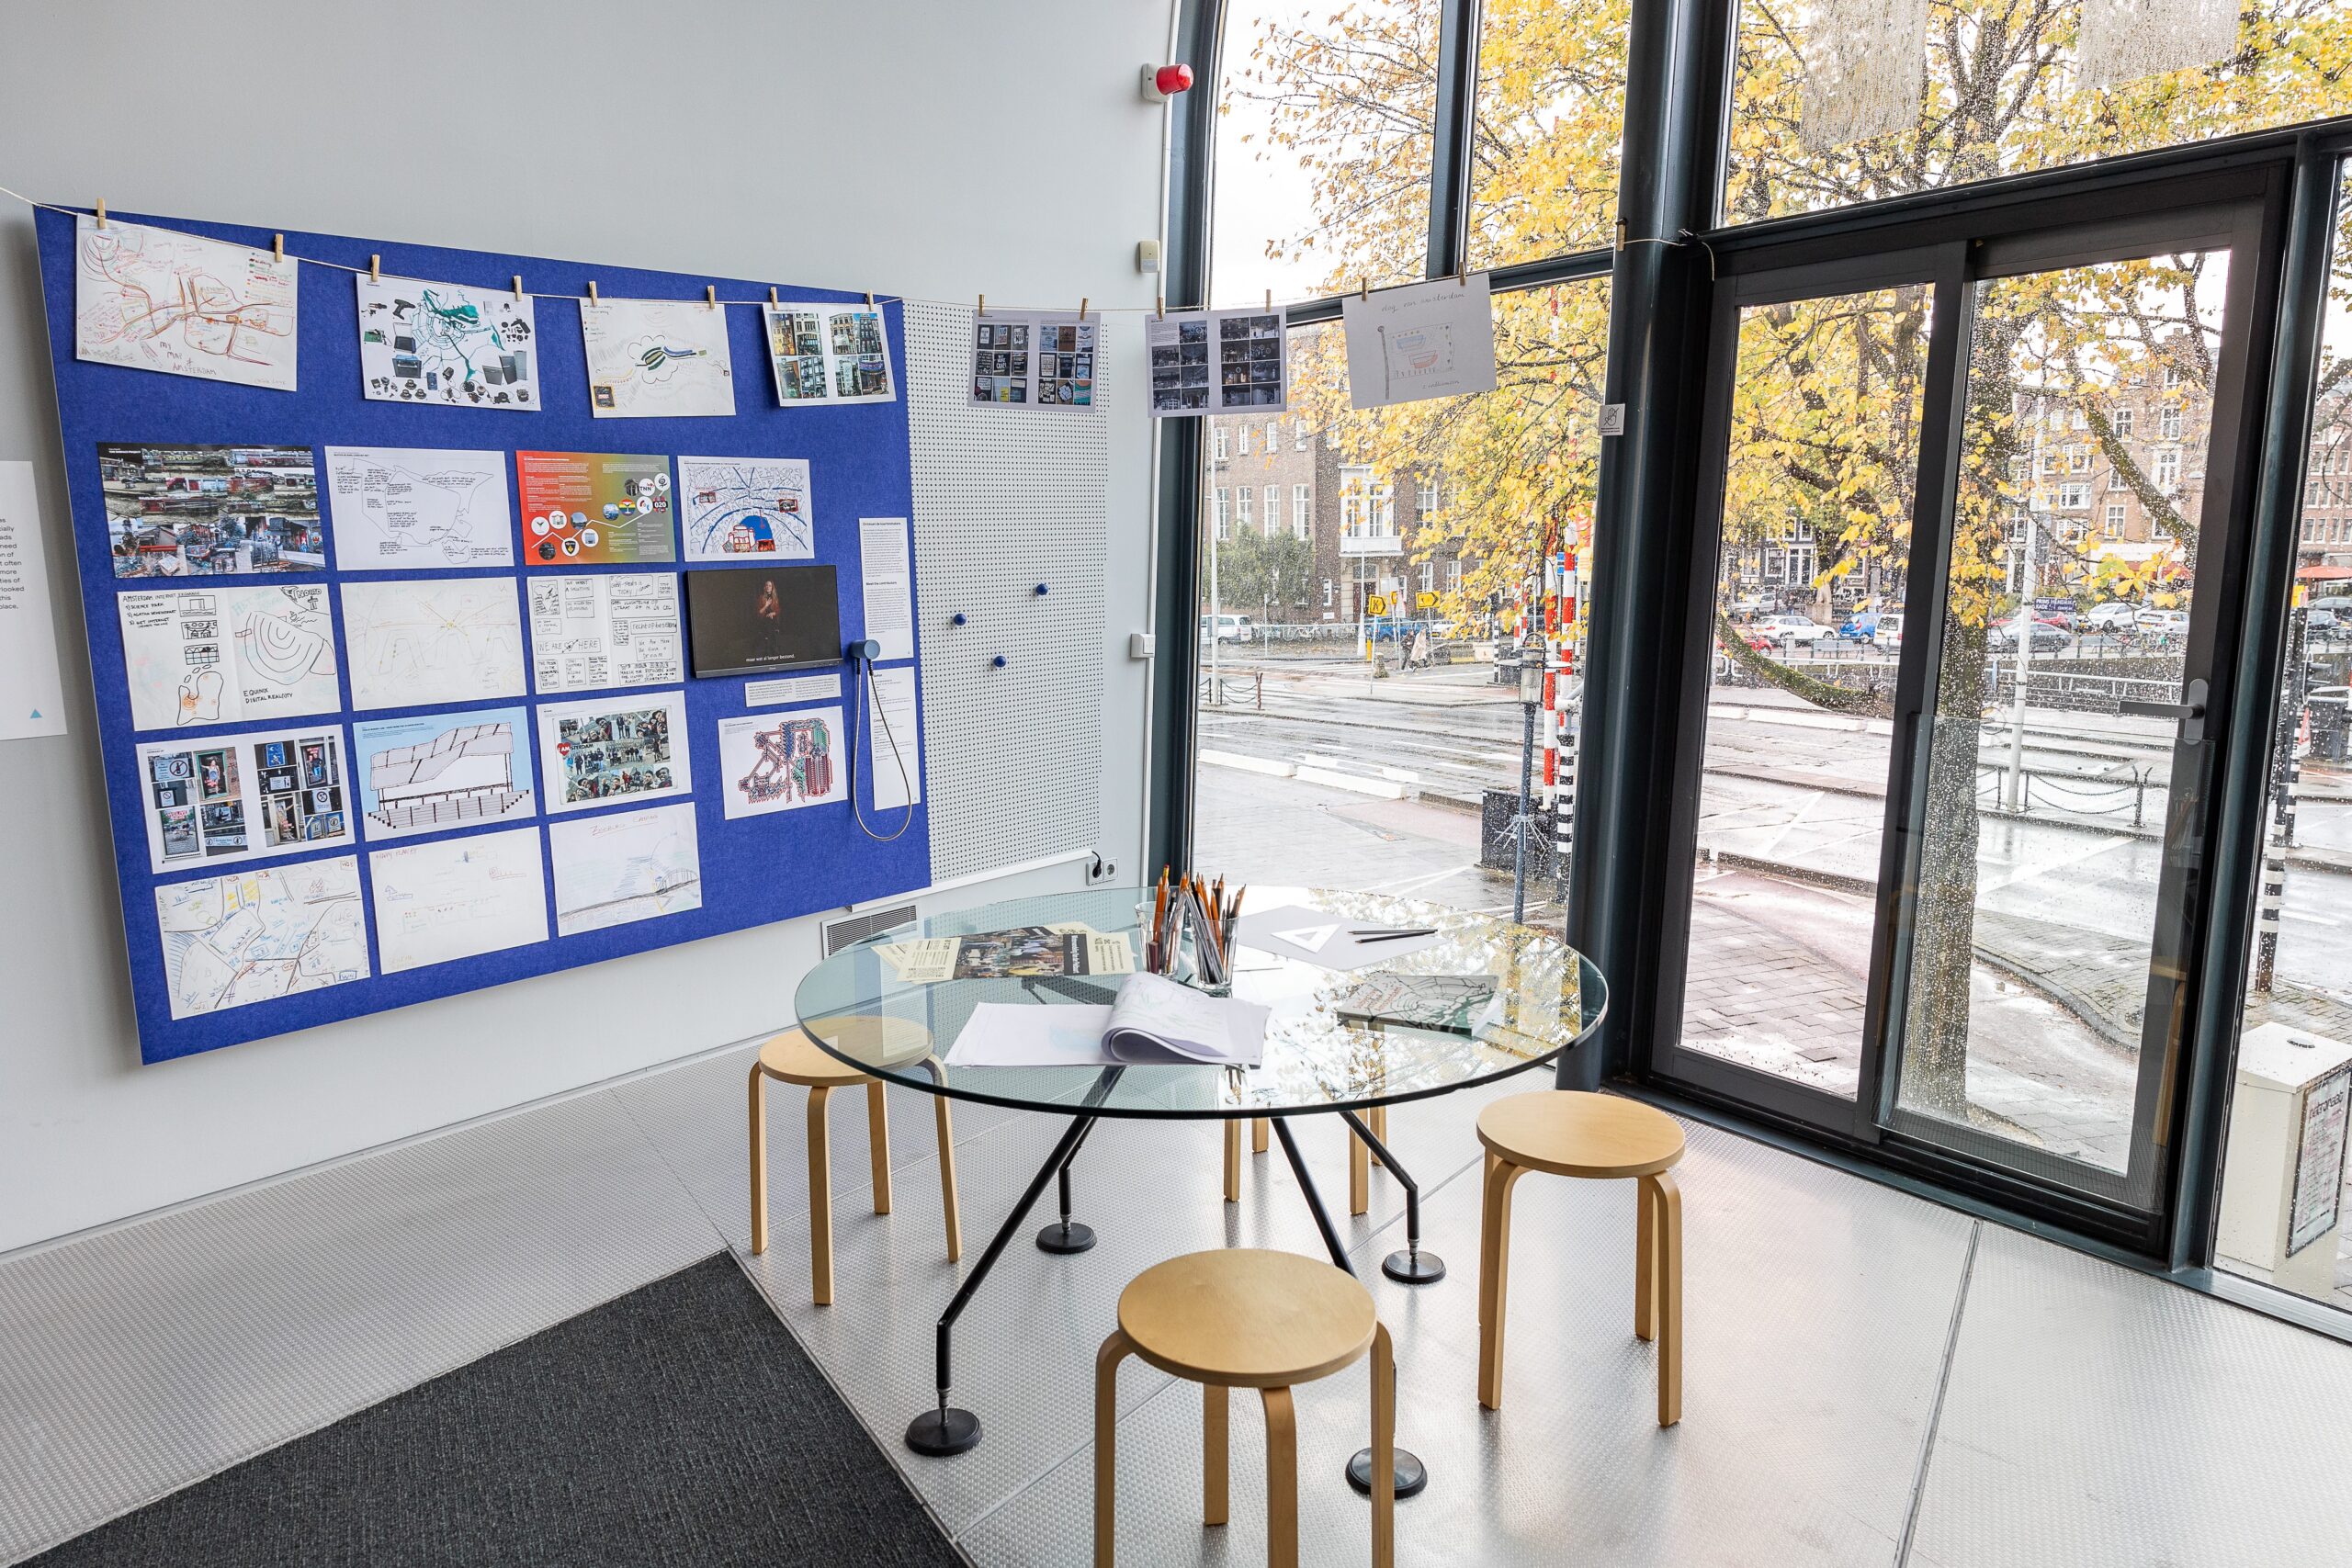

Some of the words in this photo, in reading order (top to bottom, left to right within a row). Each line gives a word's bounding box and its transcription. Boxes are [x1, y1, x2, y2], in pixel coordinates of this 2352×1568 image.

[172, 364, 217, 376] AMSTERDAM
[578, 639, 598, 651] HERE
[245, 695, 267, 704] DIGITAL
